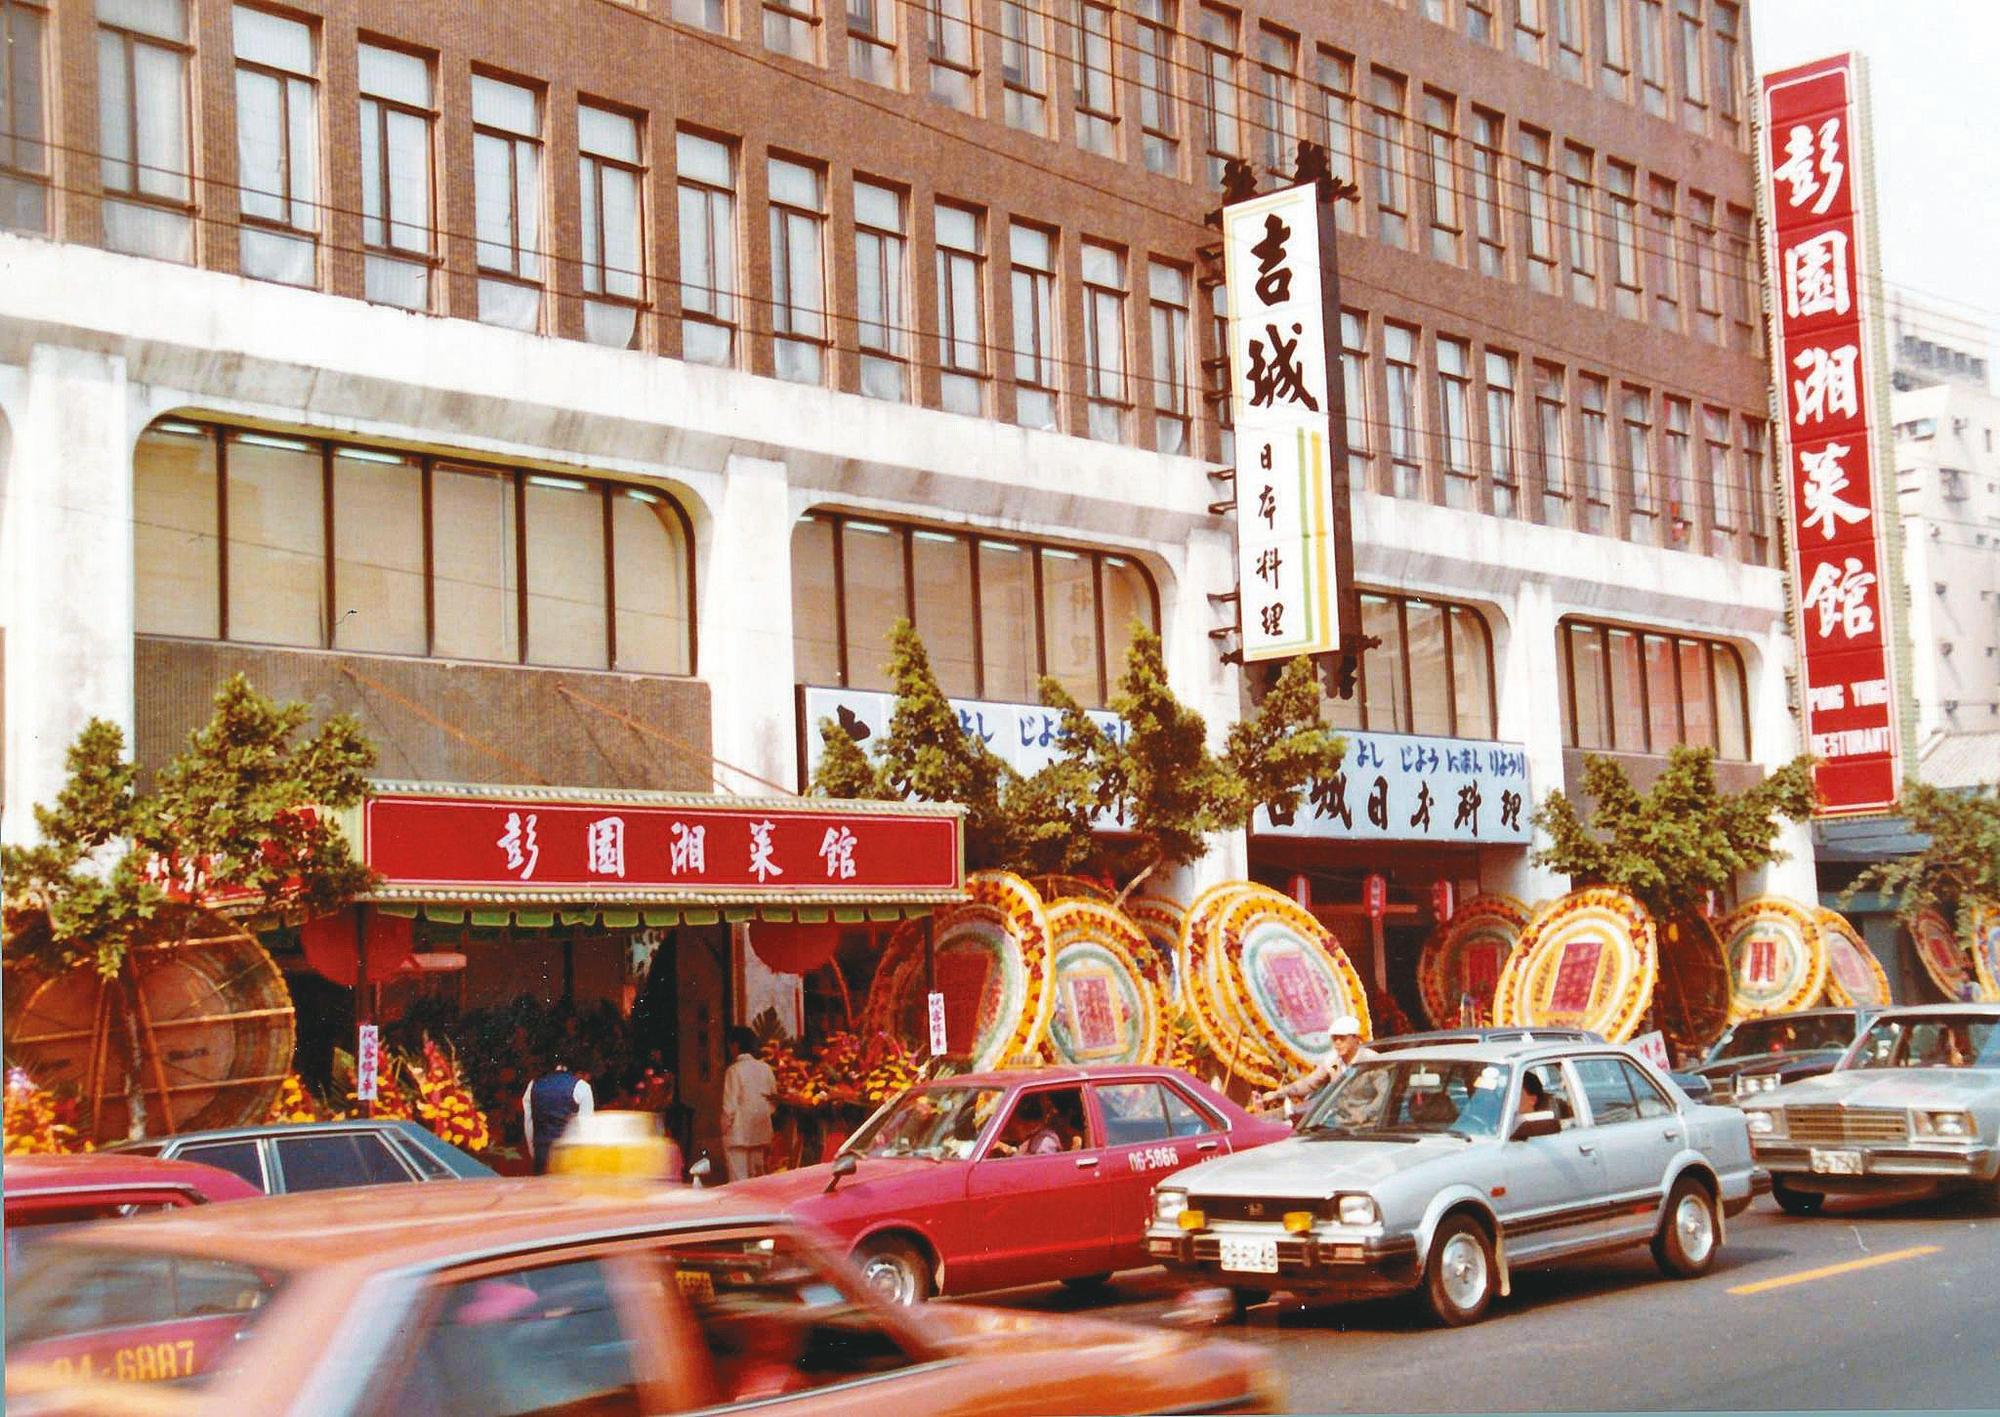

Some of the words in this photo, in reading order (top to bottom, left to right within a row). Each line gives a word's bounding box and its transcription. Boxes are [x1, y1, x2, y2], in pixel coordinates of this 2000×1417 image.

[1248, 212, 1320, 412] 吉城
[1773, 117, 1876, 639] 彭園湘菜館
[1256, 443, 1285, 638] 日本料理
[497, 811, 858, 881] 彭園湘菜館
